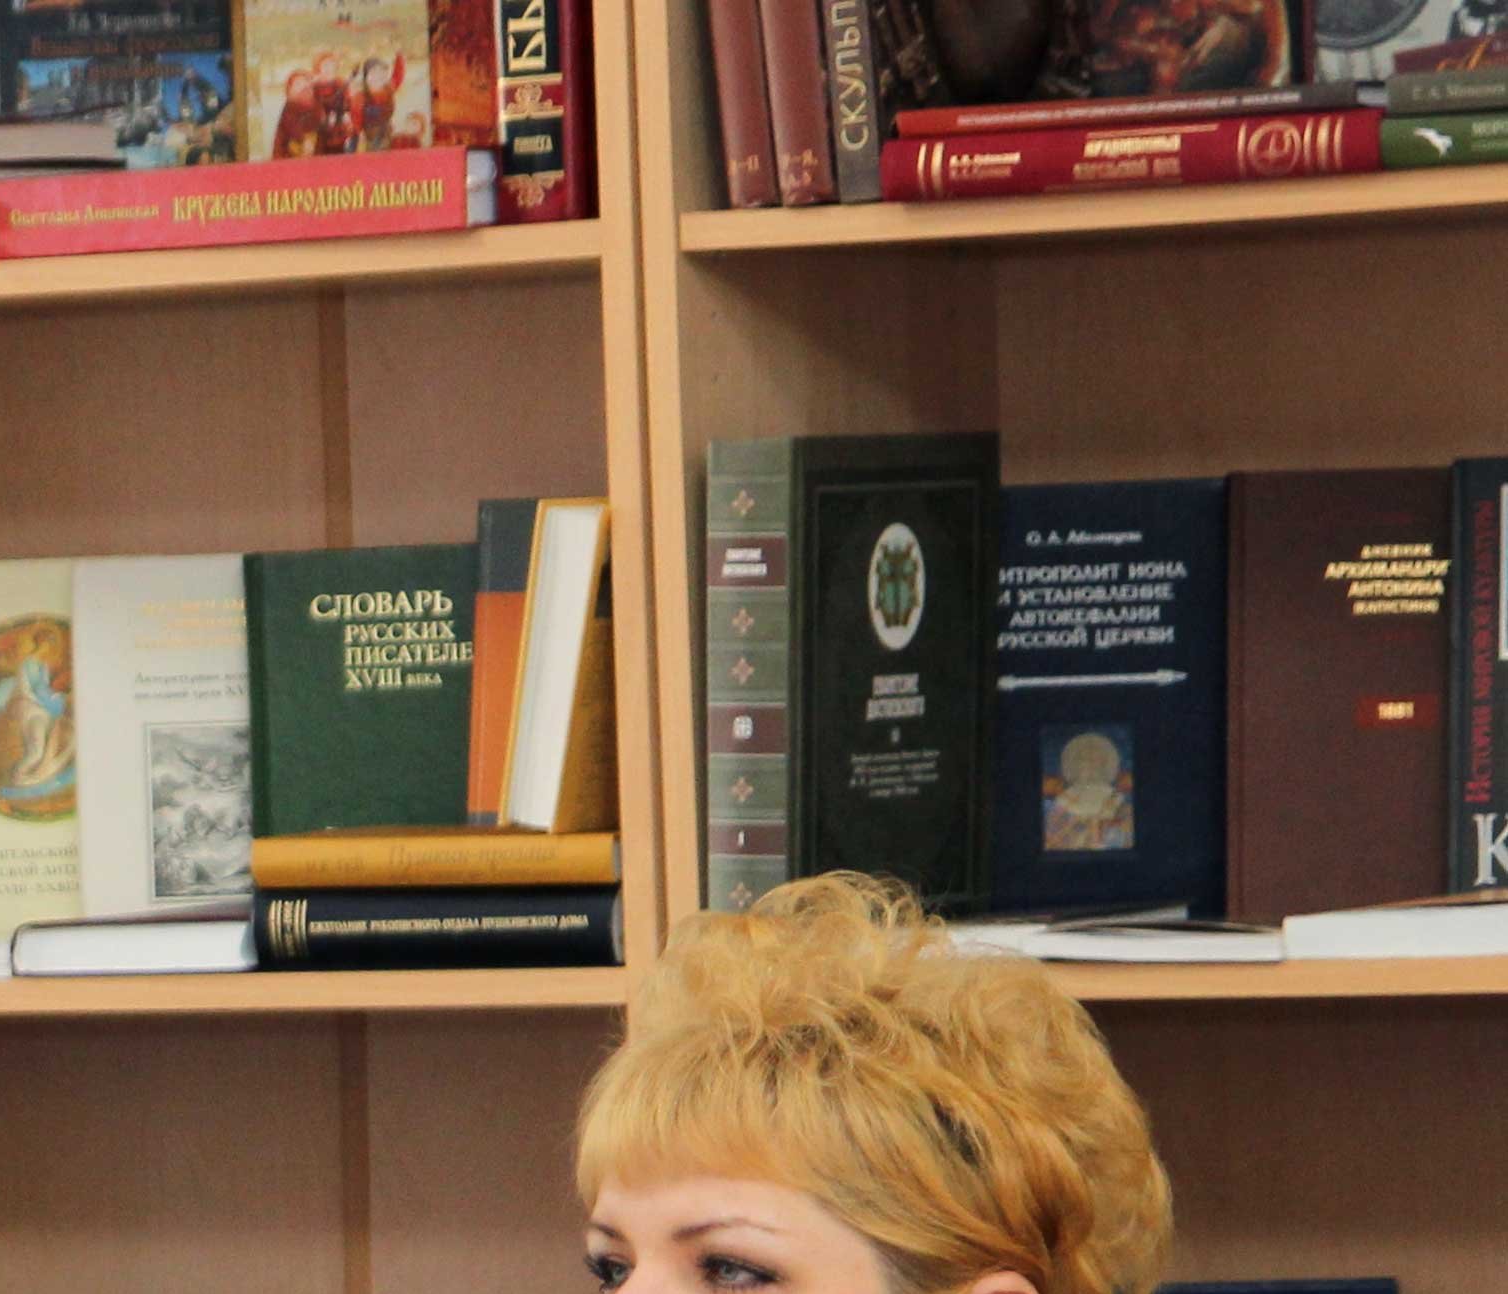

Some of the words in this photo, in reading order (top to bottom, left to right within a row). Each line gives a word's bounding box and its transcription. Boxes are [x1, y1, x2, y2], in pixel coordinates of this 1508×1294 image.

[172, 191, 261, 226] КРУЖЕВА
[265, 180, 366, 216] НАРОДНОЙ
[369, 179, 444, 209] МЫСЛИ
[1127, 560, 1188, 580] ИОНА
[309, 589, 454, 622] СЛОВАРЬ
[1017, 582, 1176, 607] УСТАНОВЛЕНИЕ
[1008, 605, 1162, 629] АВТОКЕФАЛИИ
[343, 620, 456, 646] РУССКИХ
[1093, 625, 1176, 651] ЦЕРКВИ
[343, 666, 403, 691] XVIII
[310, 920, 367, 935] ЕЖЕГОДНИК
[370, 918, 442, 934] РУКОПИСНОГО
[481, 915, 558, 931] ПУШКИНСКОГО
[558, 914, 590, 929] ДОМА
